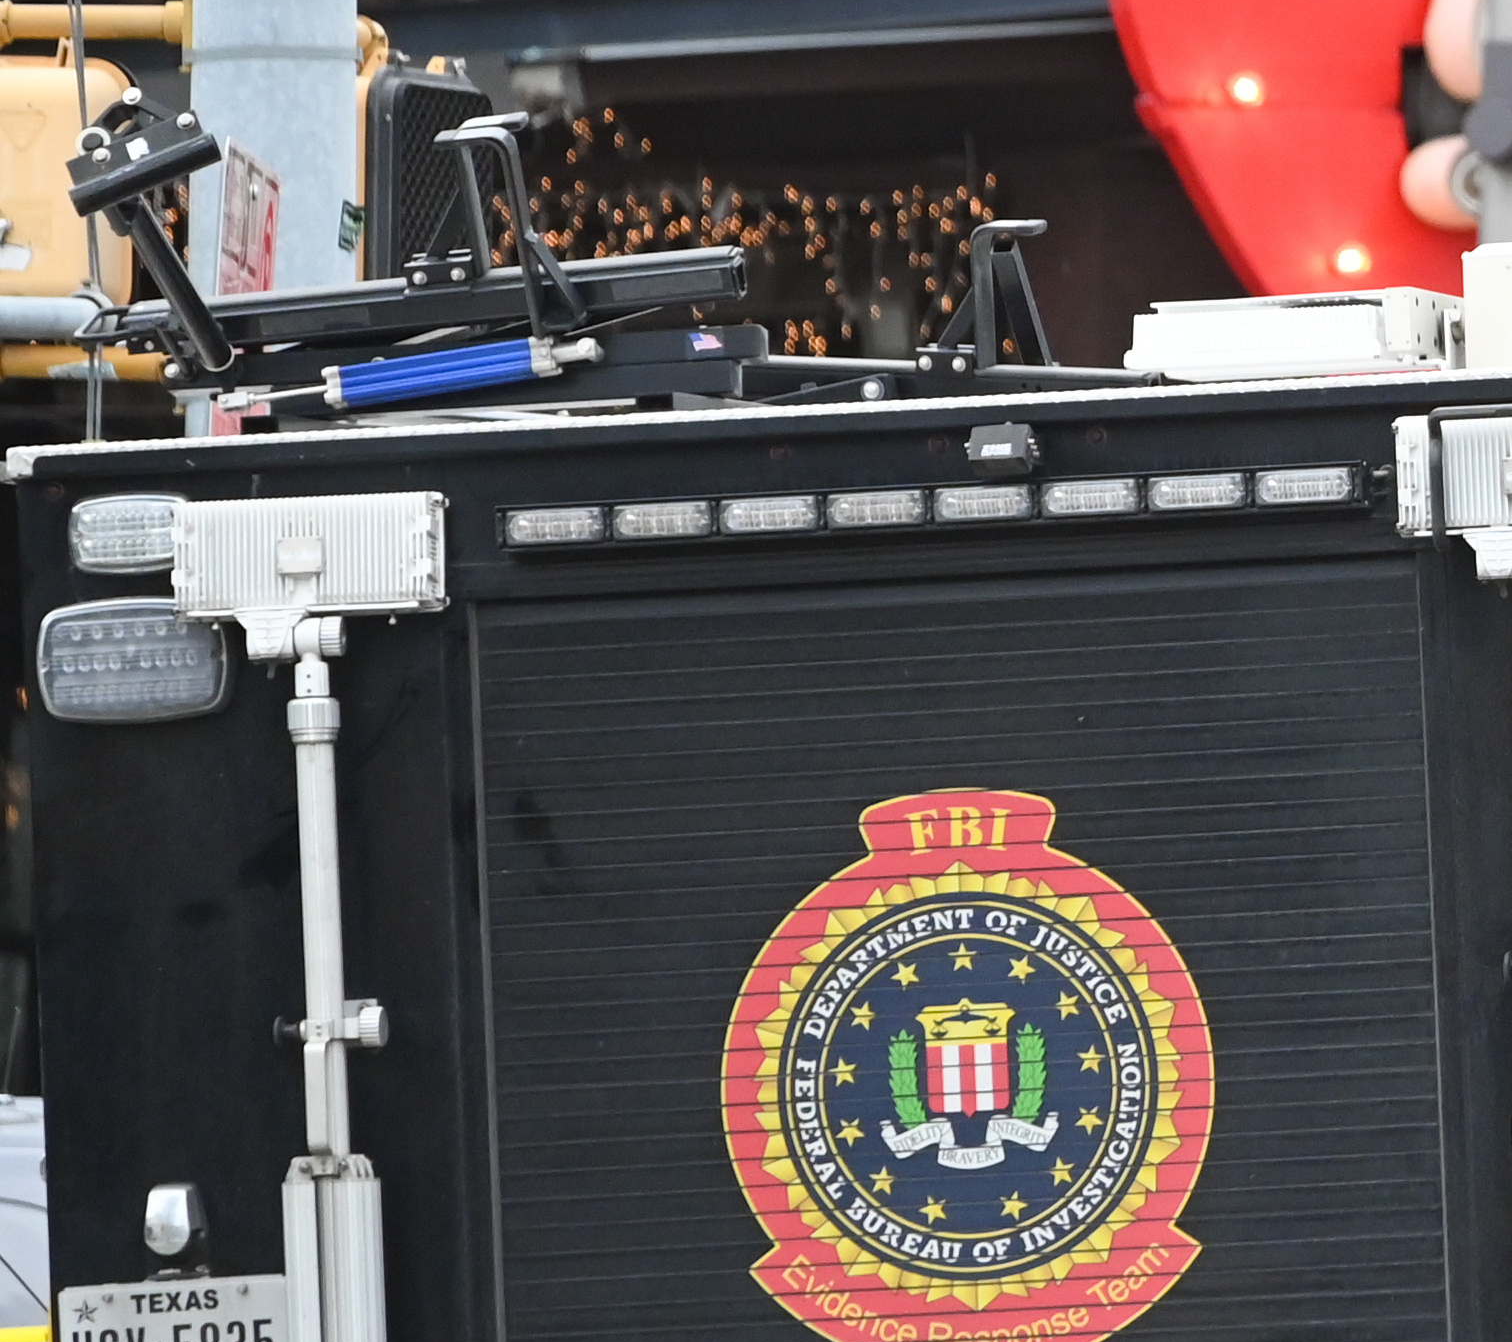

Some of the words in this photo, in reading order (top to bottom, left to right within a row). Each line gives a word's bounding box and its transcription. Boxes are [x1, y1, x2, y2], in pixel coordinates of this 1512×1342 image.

[904, 805, 1012, 855] FBI
[804, 908, 974, 1039] DEPARTMENT
[985, 910, 1027, 939] OF
[1031, 924, 1128, 1025] JUSTICE
[795, 1057, 845, 1200] FEDERAL
[845, 1195, 963, 1263] BUREAU
[972, 1238, 1014, 1264] OF
[1021, 1041, 1141, 1253] INVESTIGATION
[893, 1124, 946, 1153] FIDELITY
[941, 1148, 1001, 1165] BRAVERY
[991, 1120, 1049, 1145] INTEGRITY
[130, 1289, 219, 1314] TEXAS
[781, 1251, 918, 1342] Evidence
[1086, 1240, 1171, 1312] Team
